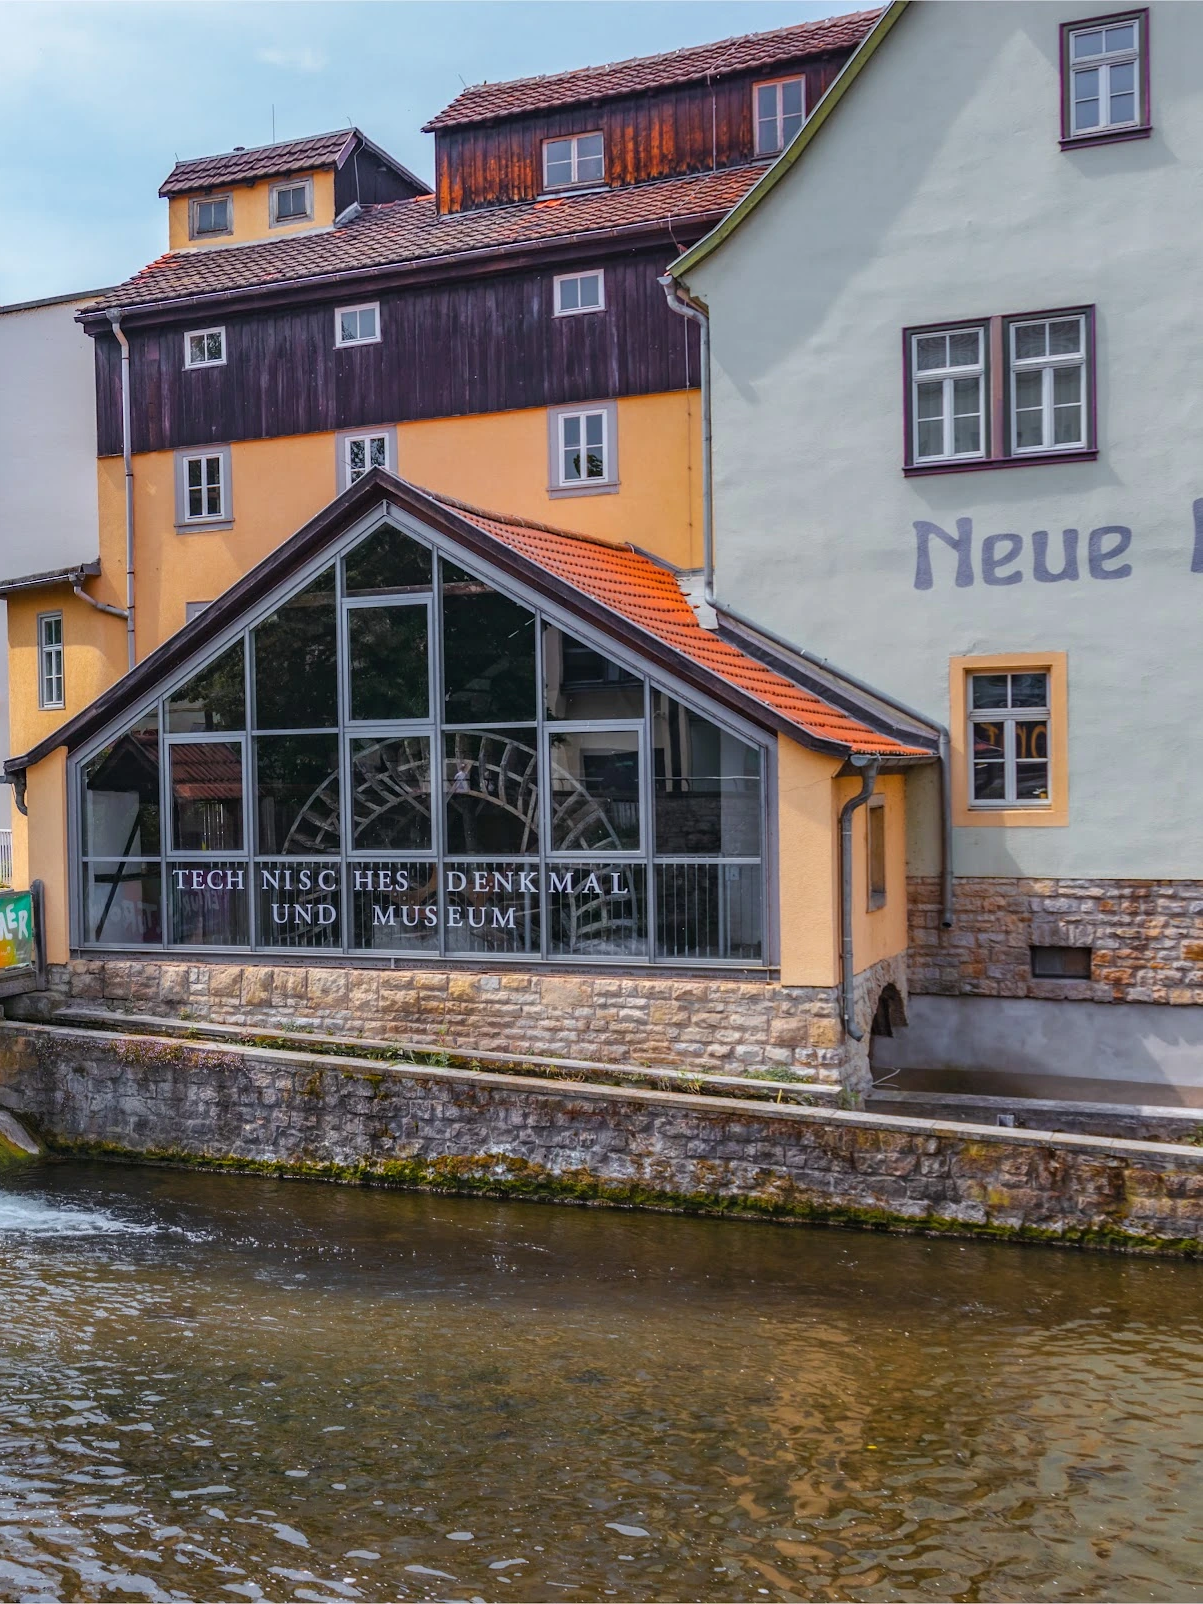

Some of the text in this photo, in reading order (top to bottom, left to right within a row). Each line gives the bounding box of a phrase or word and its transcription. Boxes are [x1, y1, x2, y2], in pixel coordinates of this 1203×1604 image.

[912, 517, 1132, 590] Neue
[446, 871, 628, 894] DENKMAL
[271, 903, 516, 928] UND MUSEUM
